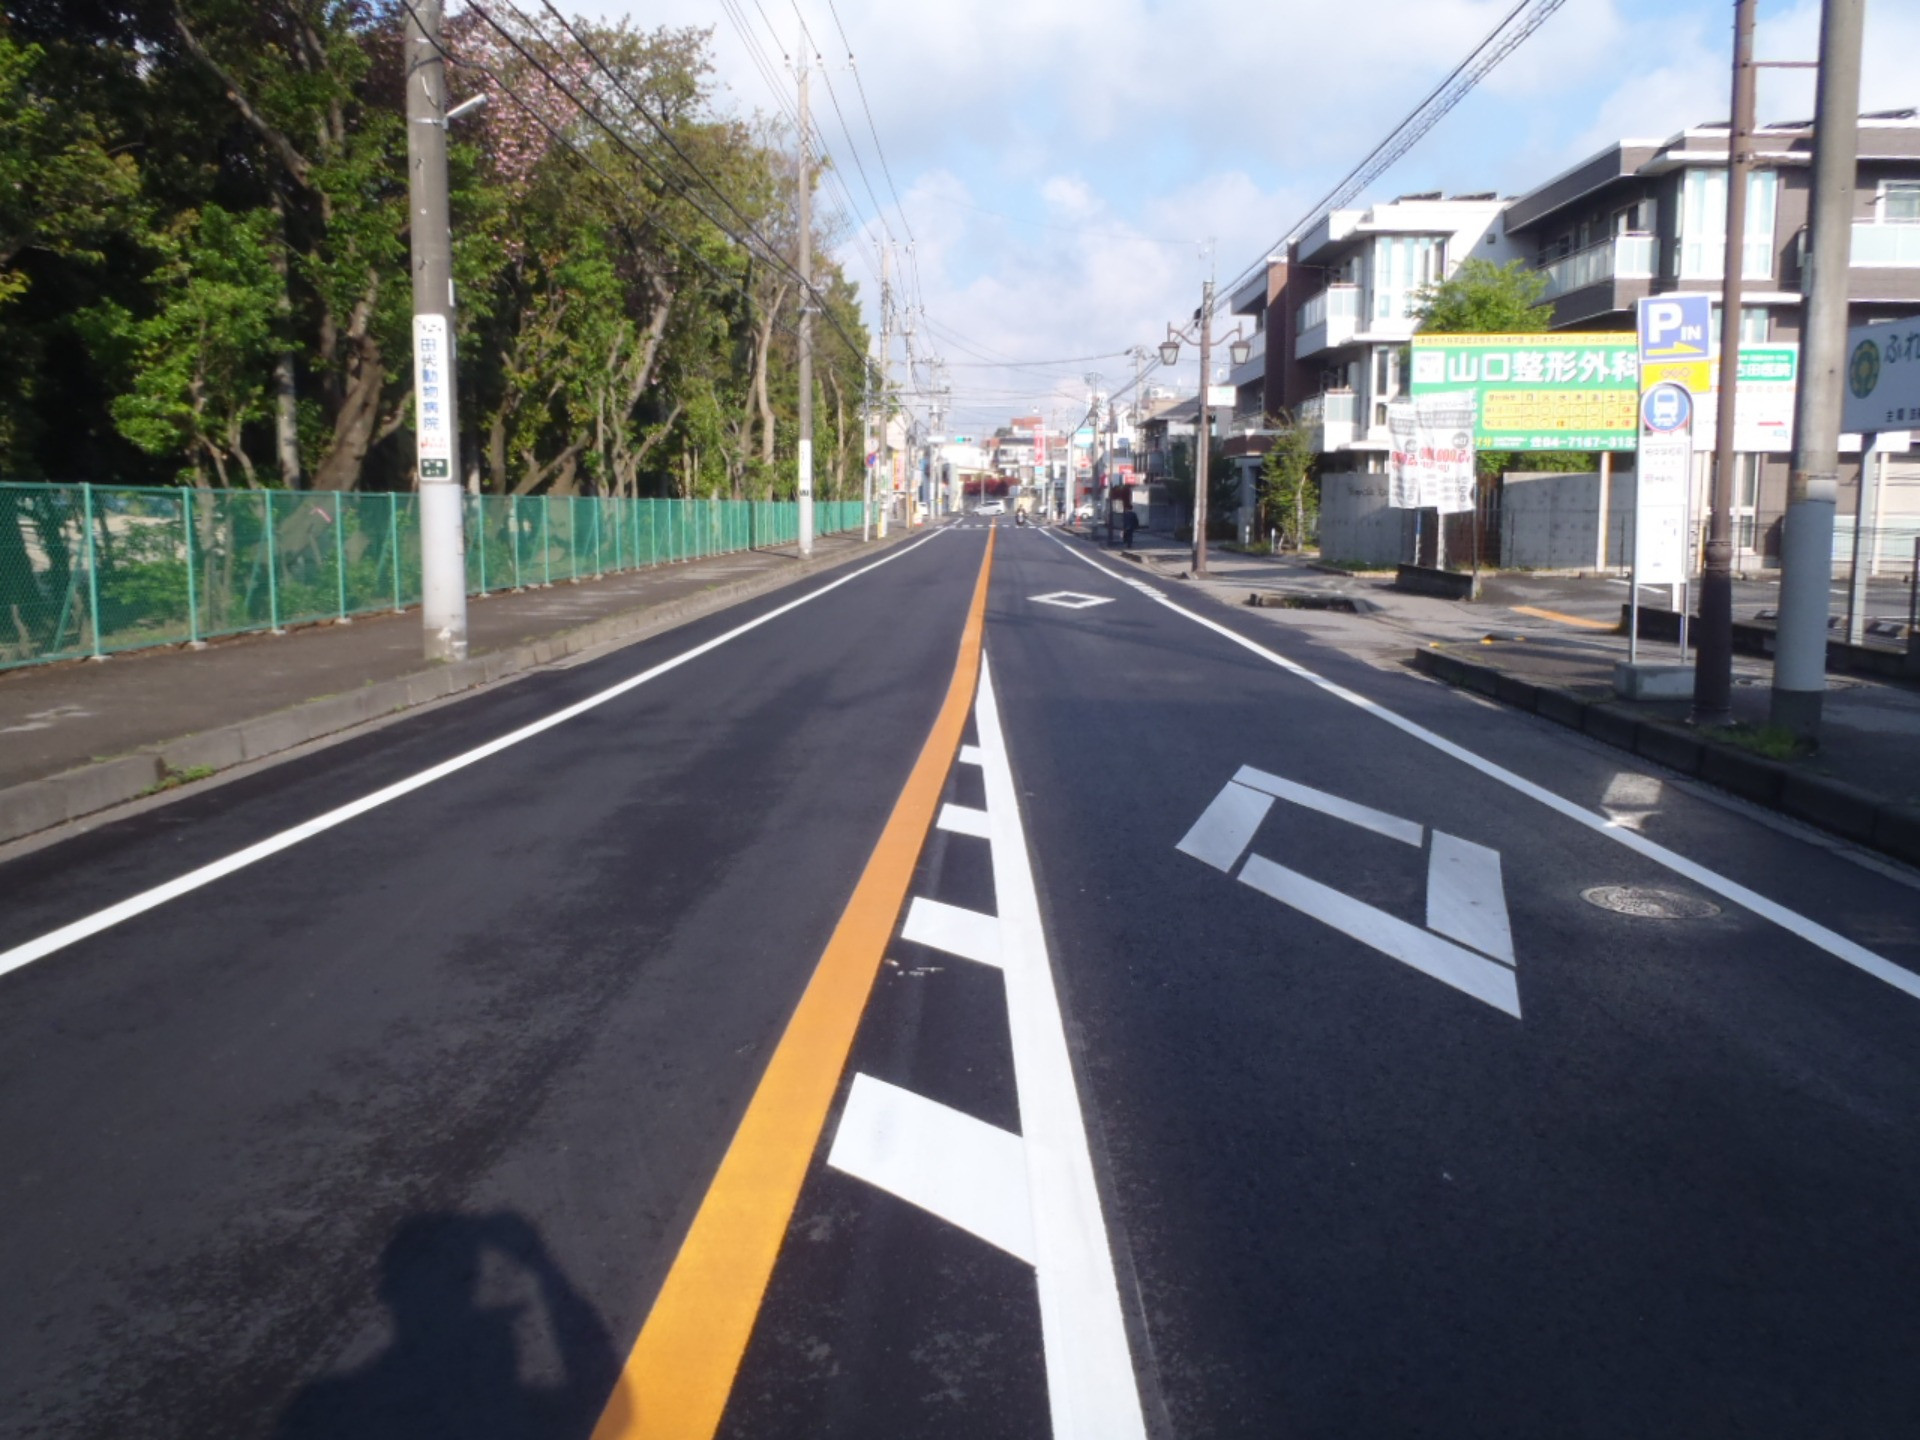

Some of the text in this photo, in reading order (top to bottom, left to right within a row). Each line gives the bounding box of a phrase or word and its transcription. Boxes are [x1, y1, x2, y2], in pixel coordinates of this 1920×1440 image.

[1648, 303, 1702, 343] P IN
[1450, 351, 1638, 383] 山口整形外科
